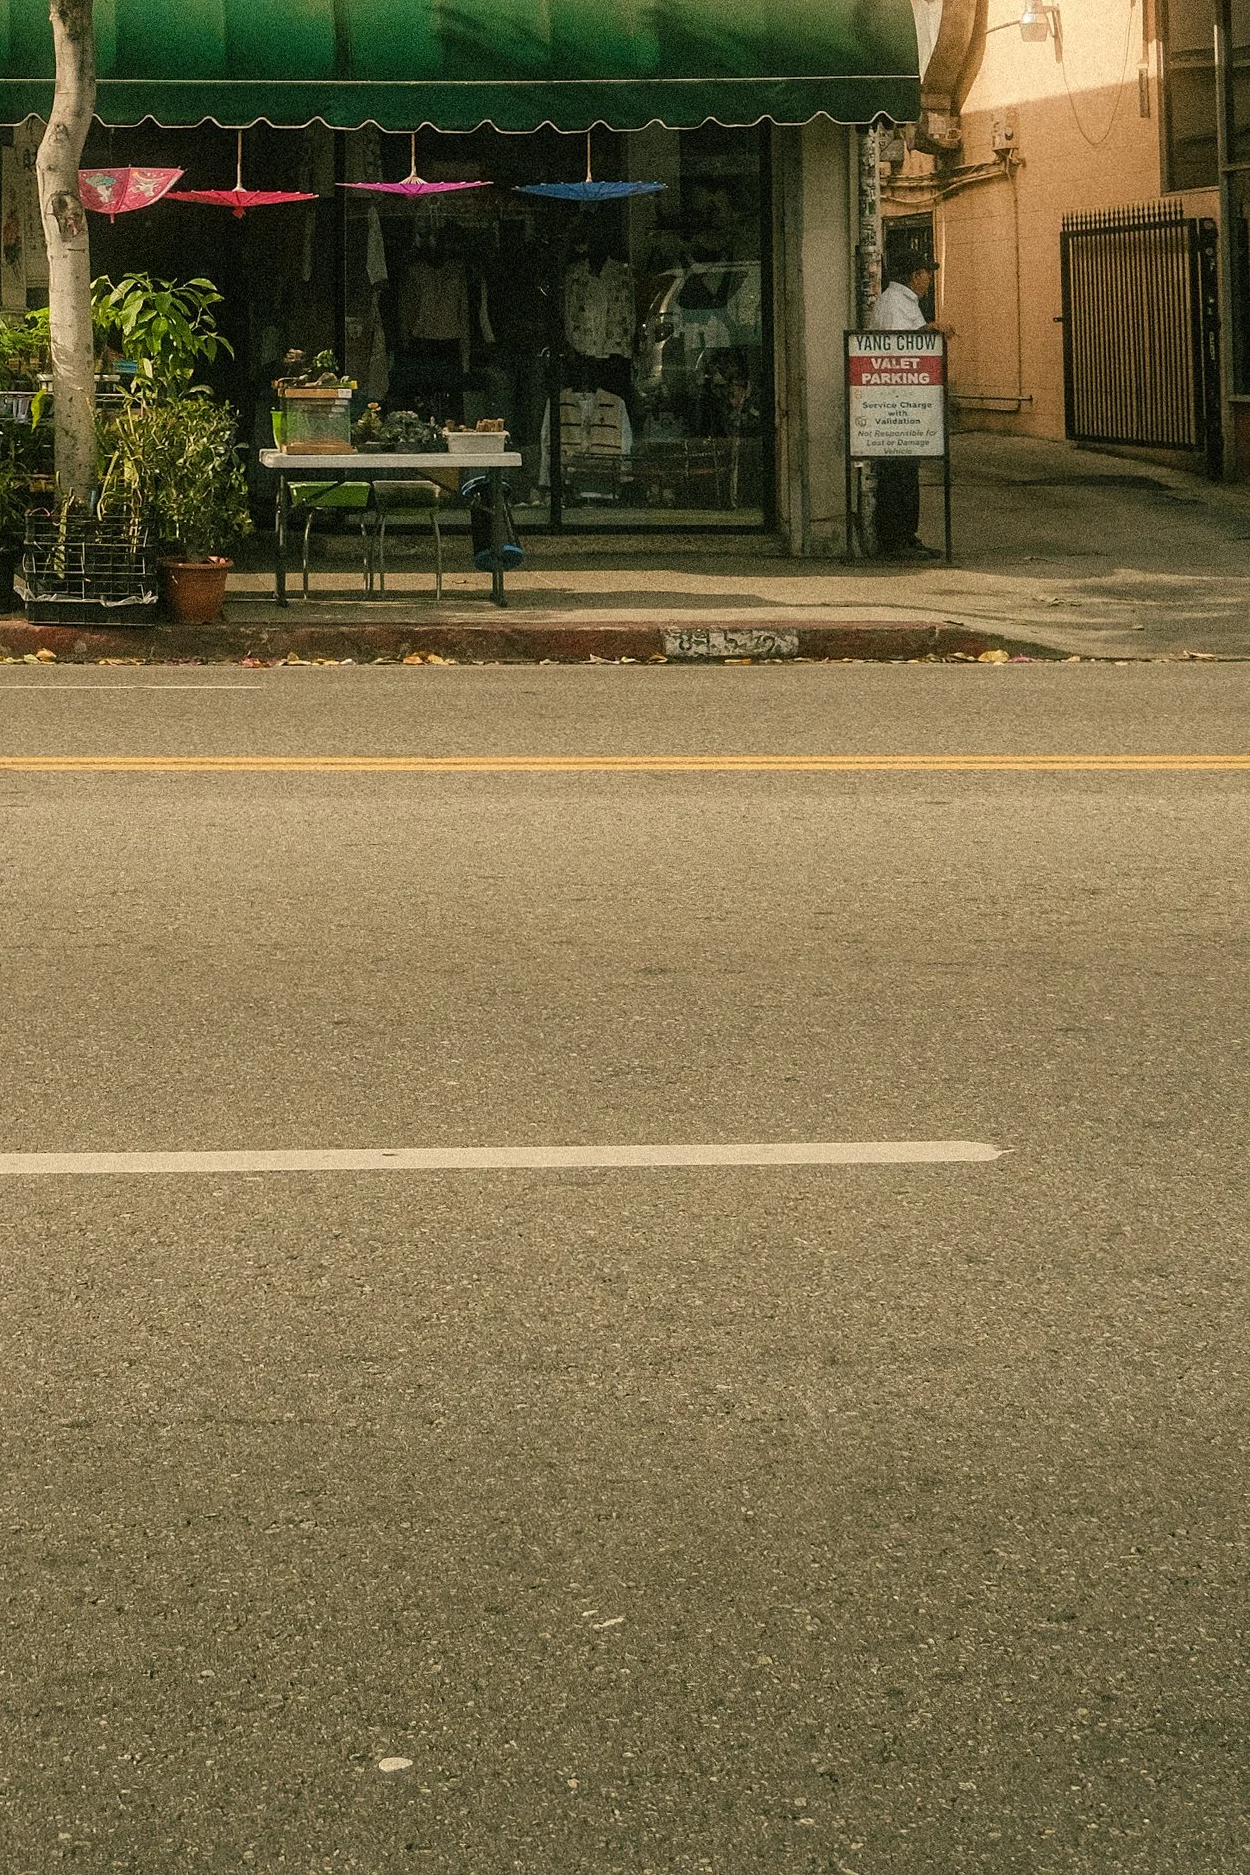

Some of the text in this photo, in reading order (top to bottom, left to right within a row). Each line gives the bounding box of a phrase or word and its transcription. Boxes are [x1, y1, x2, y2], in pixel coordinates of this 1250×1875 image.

[855, 334, 936, 351] YANG CHOW
[870, 357, 920, 370] VALET
[861, 372, 930, 385] PARKING
[862, 401, 933, 410] Service Charge
[873, 429, 924, 438] Responsible
[925, 429, 939, 437] for
[897, 439, 930, 447] Damage
